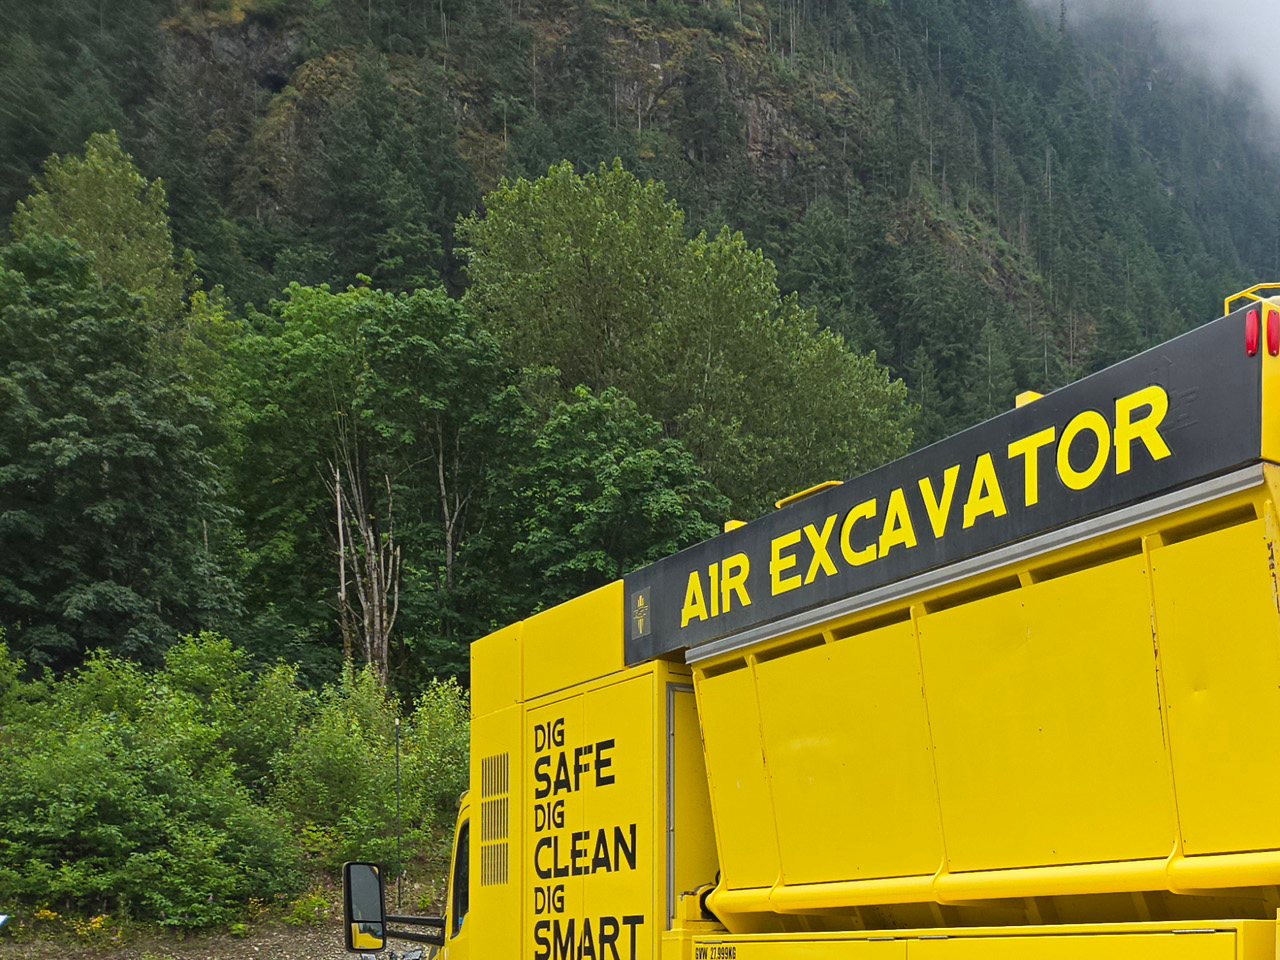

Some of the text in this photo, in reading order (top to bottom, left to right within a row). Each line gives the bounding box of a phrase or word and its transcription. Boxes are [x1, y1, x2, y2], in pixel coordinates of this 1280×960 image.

[680, 385, 1172, 628] AIR EXCAVATOR
[534, 717, 565, 753] DIG
[534, 738, 616, 800] SAFE
[534, 800, 565, 833] DIG
[533, 823, 638, 880] CLEAN
[533, 884, 565, 915] DIG
[695, 947, 708, 960] GVW
